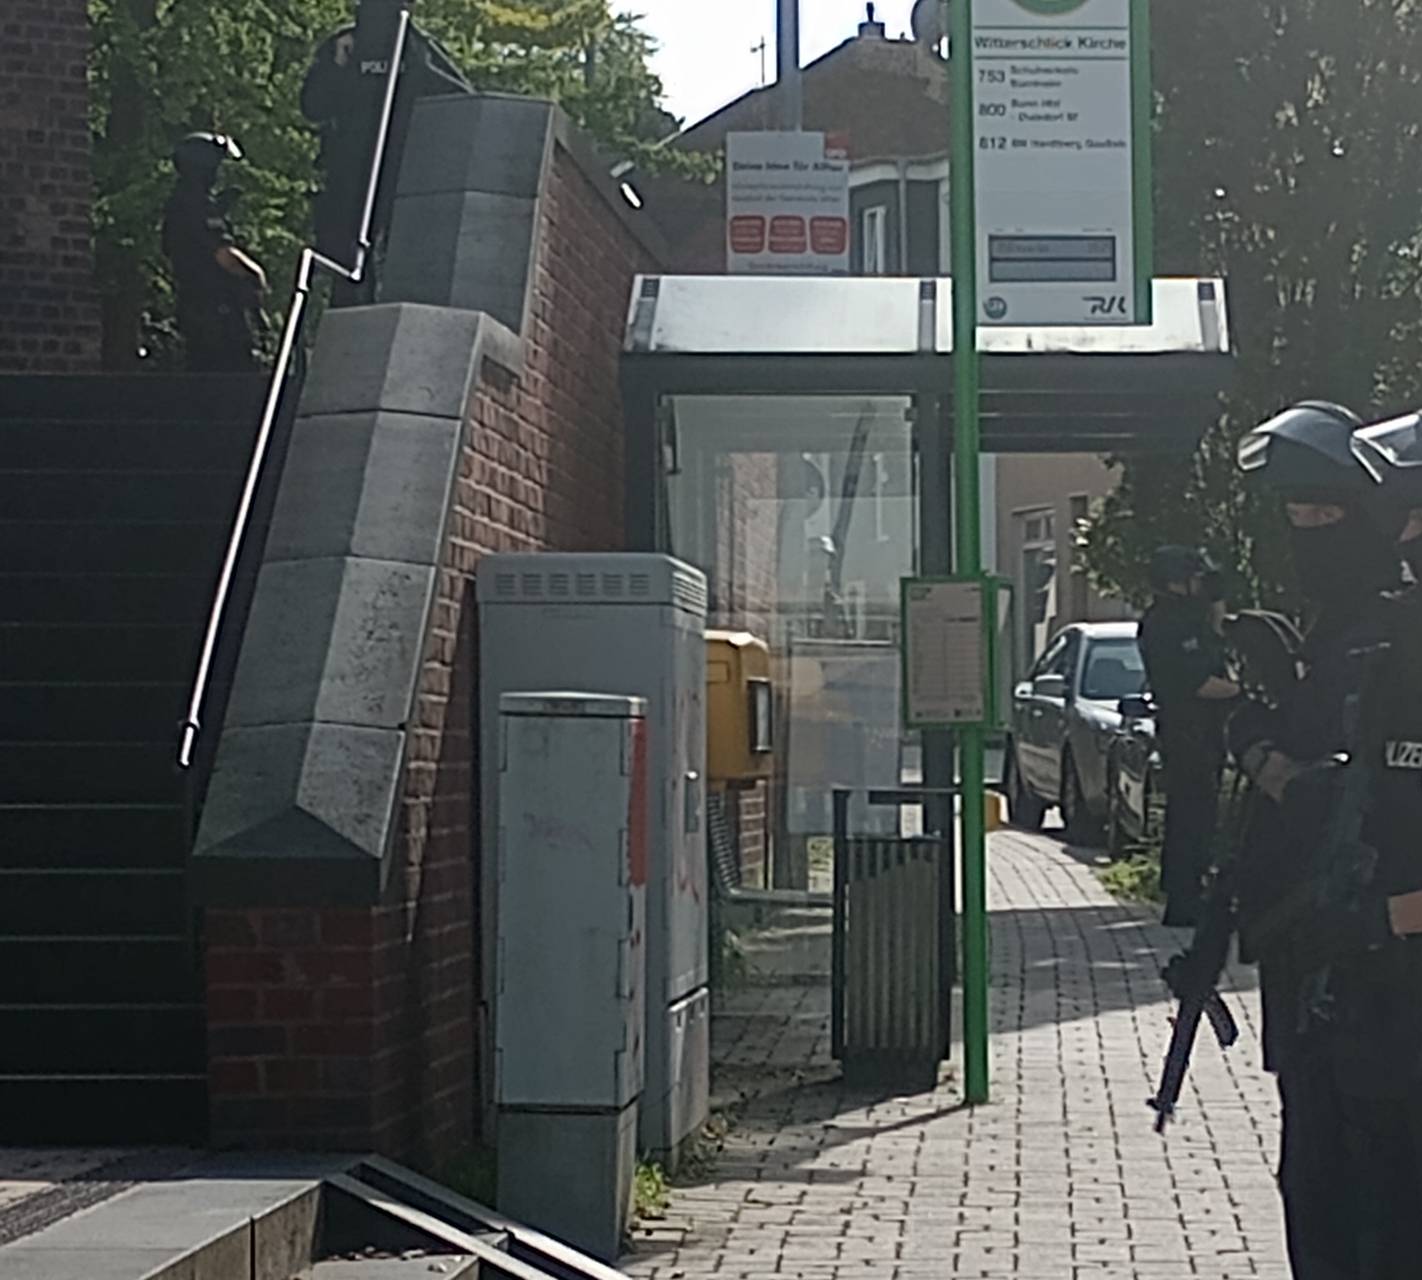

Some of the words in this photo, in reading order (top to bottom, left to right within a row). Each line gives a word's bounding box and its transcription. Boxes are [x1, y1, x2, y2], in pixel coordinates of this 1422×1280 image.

[974, 36, 1072, 49] Witterschlick
[1078, 36, 1127, 49] Kirche
[978, 69, 1006, 83] 753
[978, 103, 1007, 117] 800
